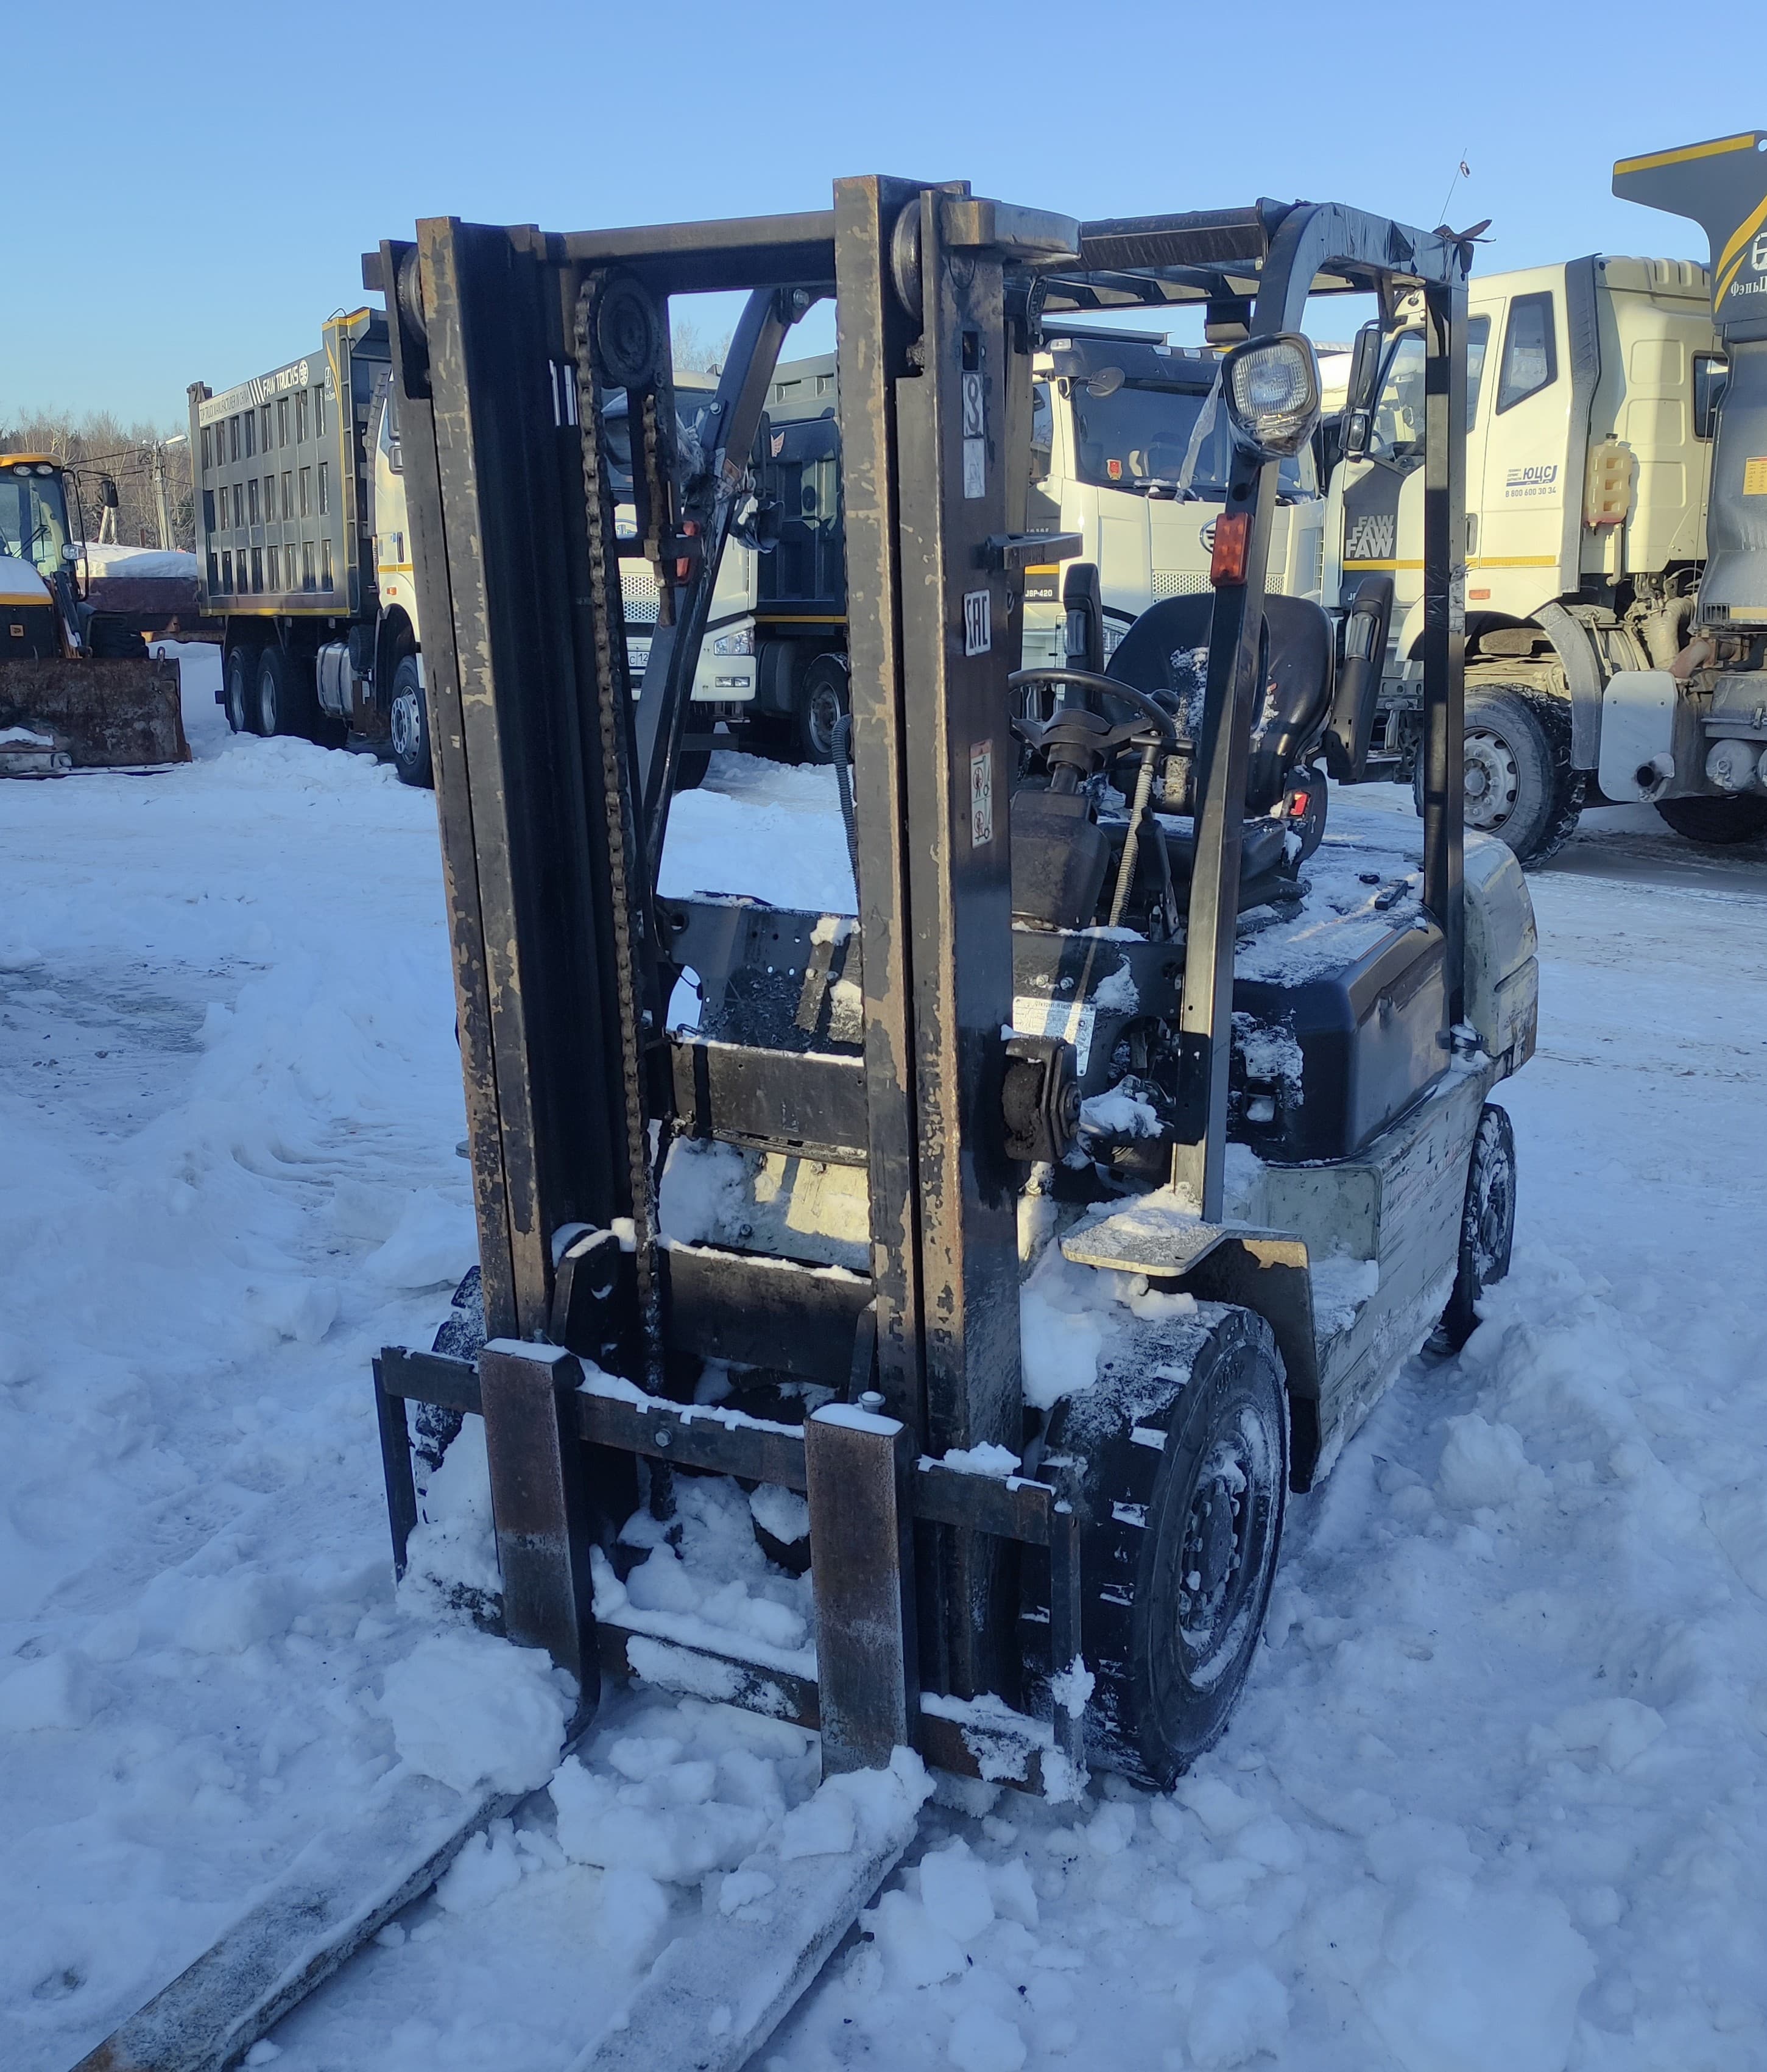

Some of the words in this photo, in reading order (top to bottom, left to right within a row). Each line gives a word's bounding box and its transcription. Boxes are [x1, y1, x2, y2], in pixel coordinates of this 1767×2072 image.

[263, 375, 275, 398] FAW
[276, 365, 298, 392] TRUCKS
[1523, 465, 1551, 482] ЮЦС
[1358, 515, 1394, 527] FAW
[1352, 526, 1394, 542] FAW
[1346, 538, 1394, 559] FAW
